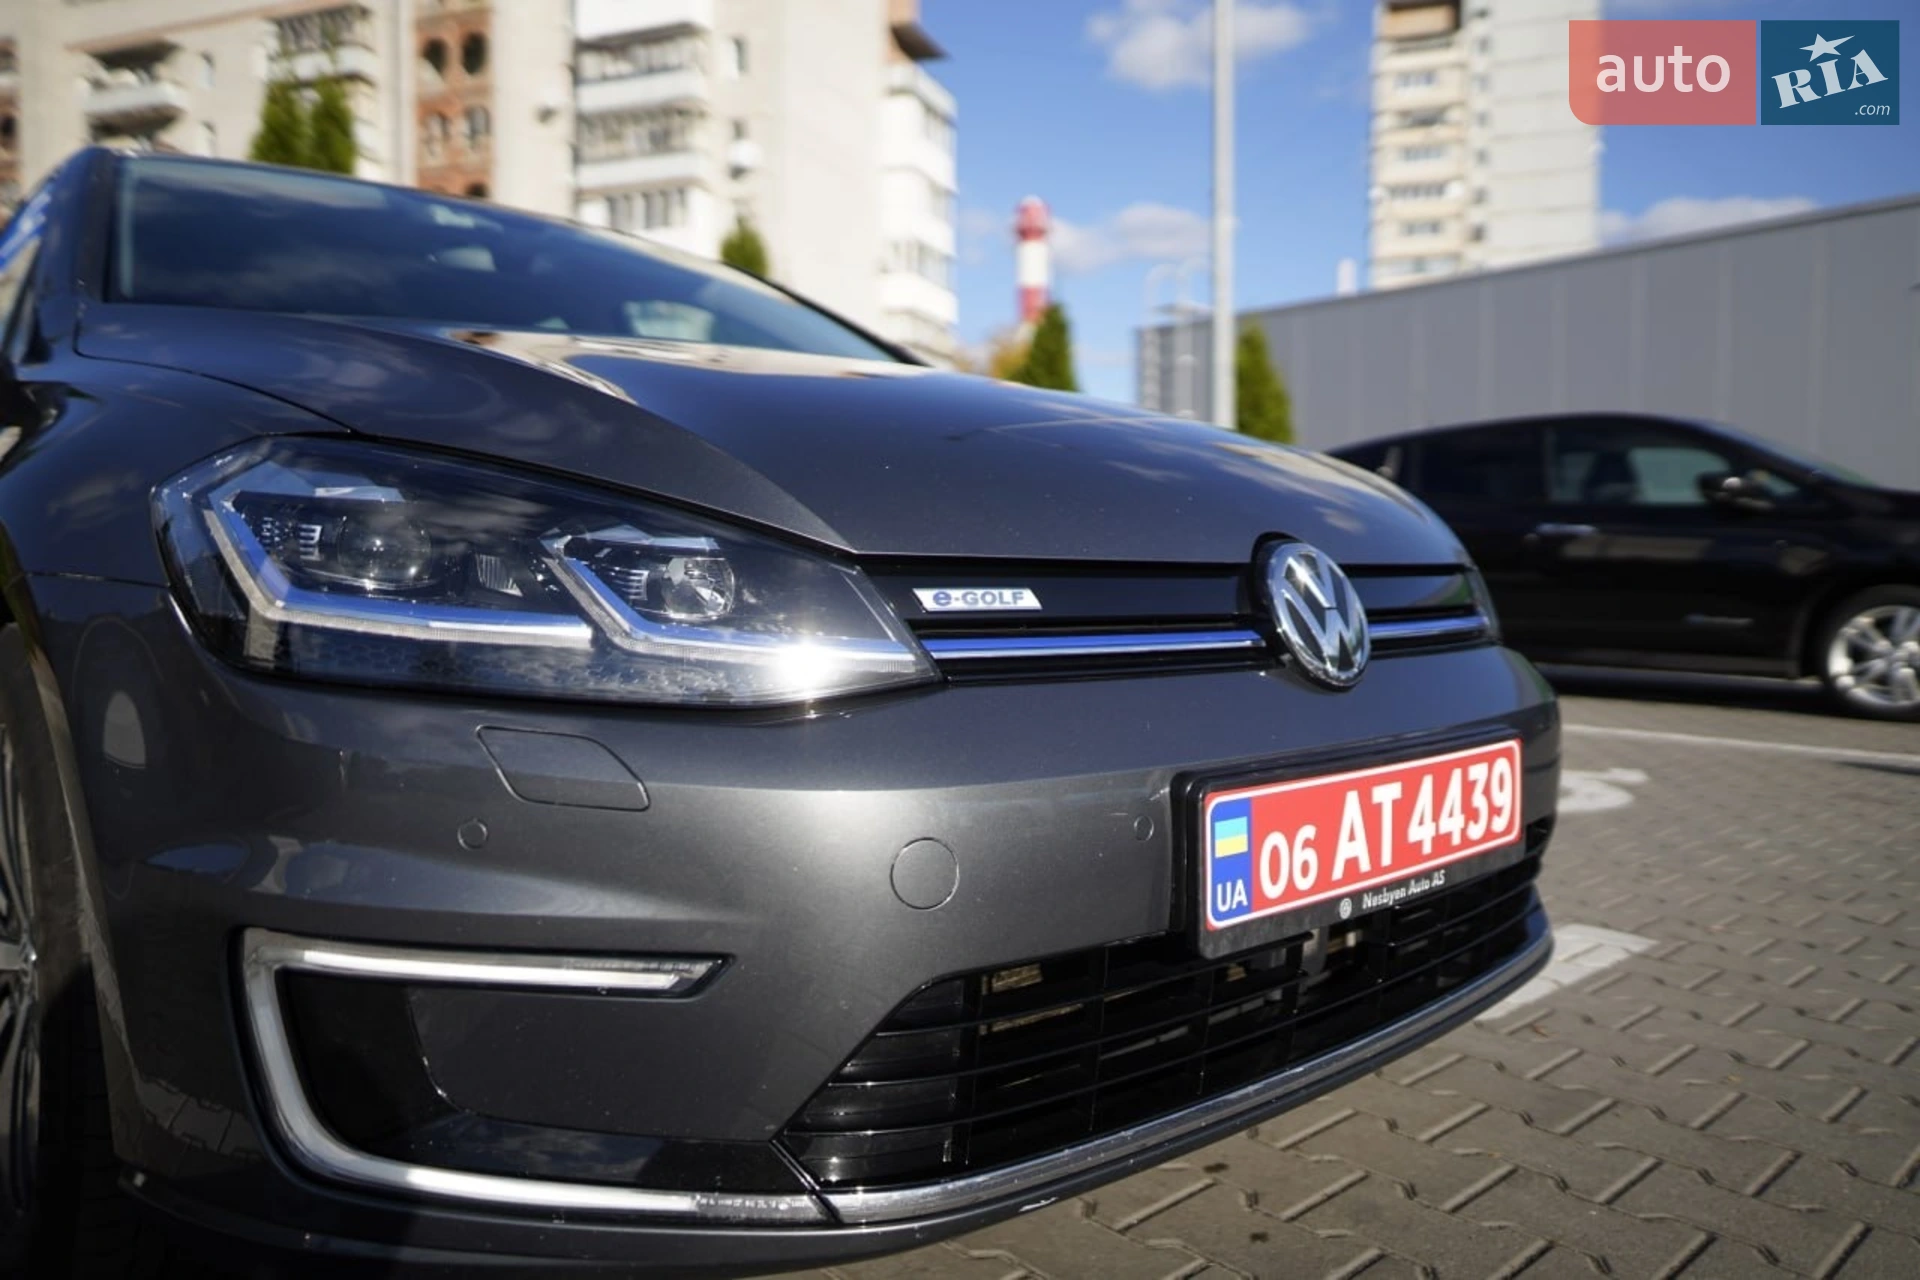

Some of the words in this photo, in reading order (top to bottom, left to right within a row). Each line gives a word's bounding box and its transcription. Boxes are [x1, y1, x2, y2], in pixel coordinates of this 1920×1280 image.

[932, 590, 1024, 607] e-GOLF
[1259, 824, 1319, 900] 06
[1217, 879, 1248, 912] UA
